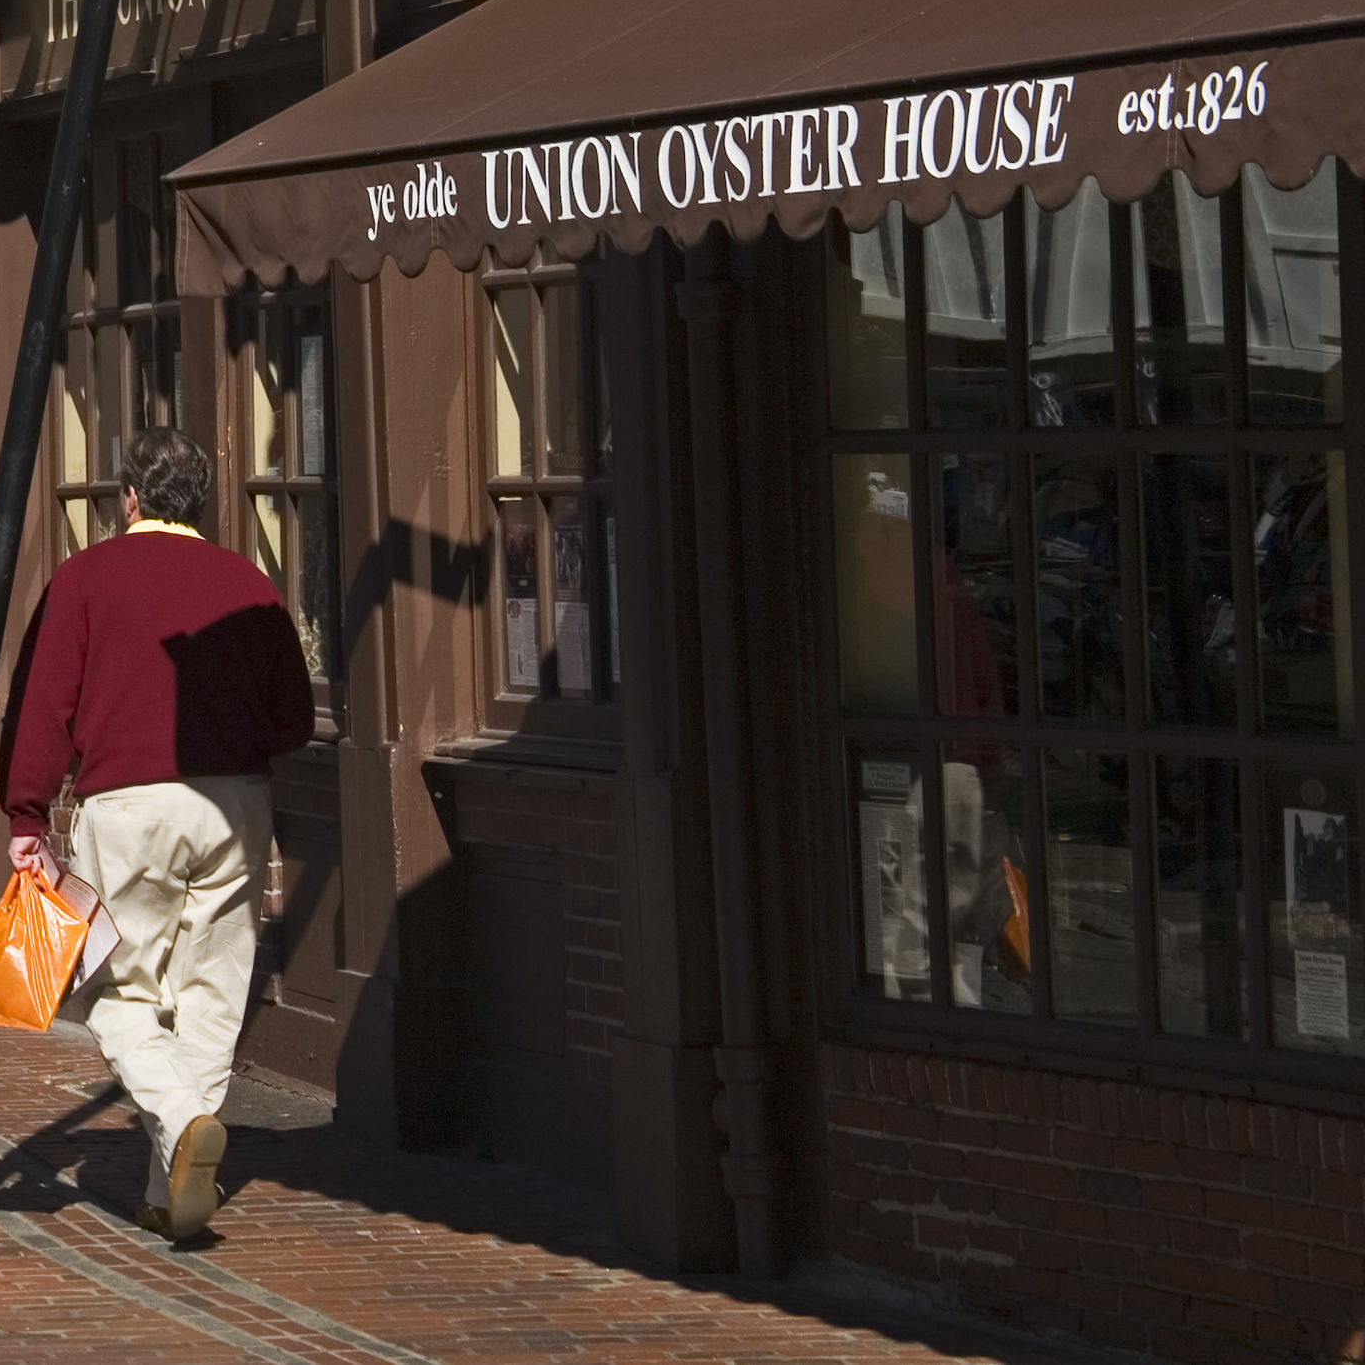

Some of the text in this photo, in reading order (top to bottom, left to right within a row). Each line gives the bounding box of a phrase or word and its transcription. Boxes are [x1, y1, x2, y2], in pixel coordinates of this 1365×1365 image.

[367, 61, 1269, 241] ye olde UNION OYSTER HOUSE est.1826
